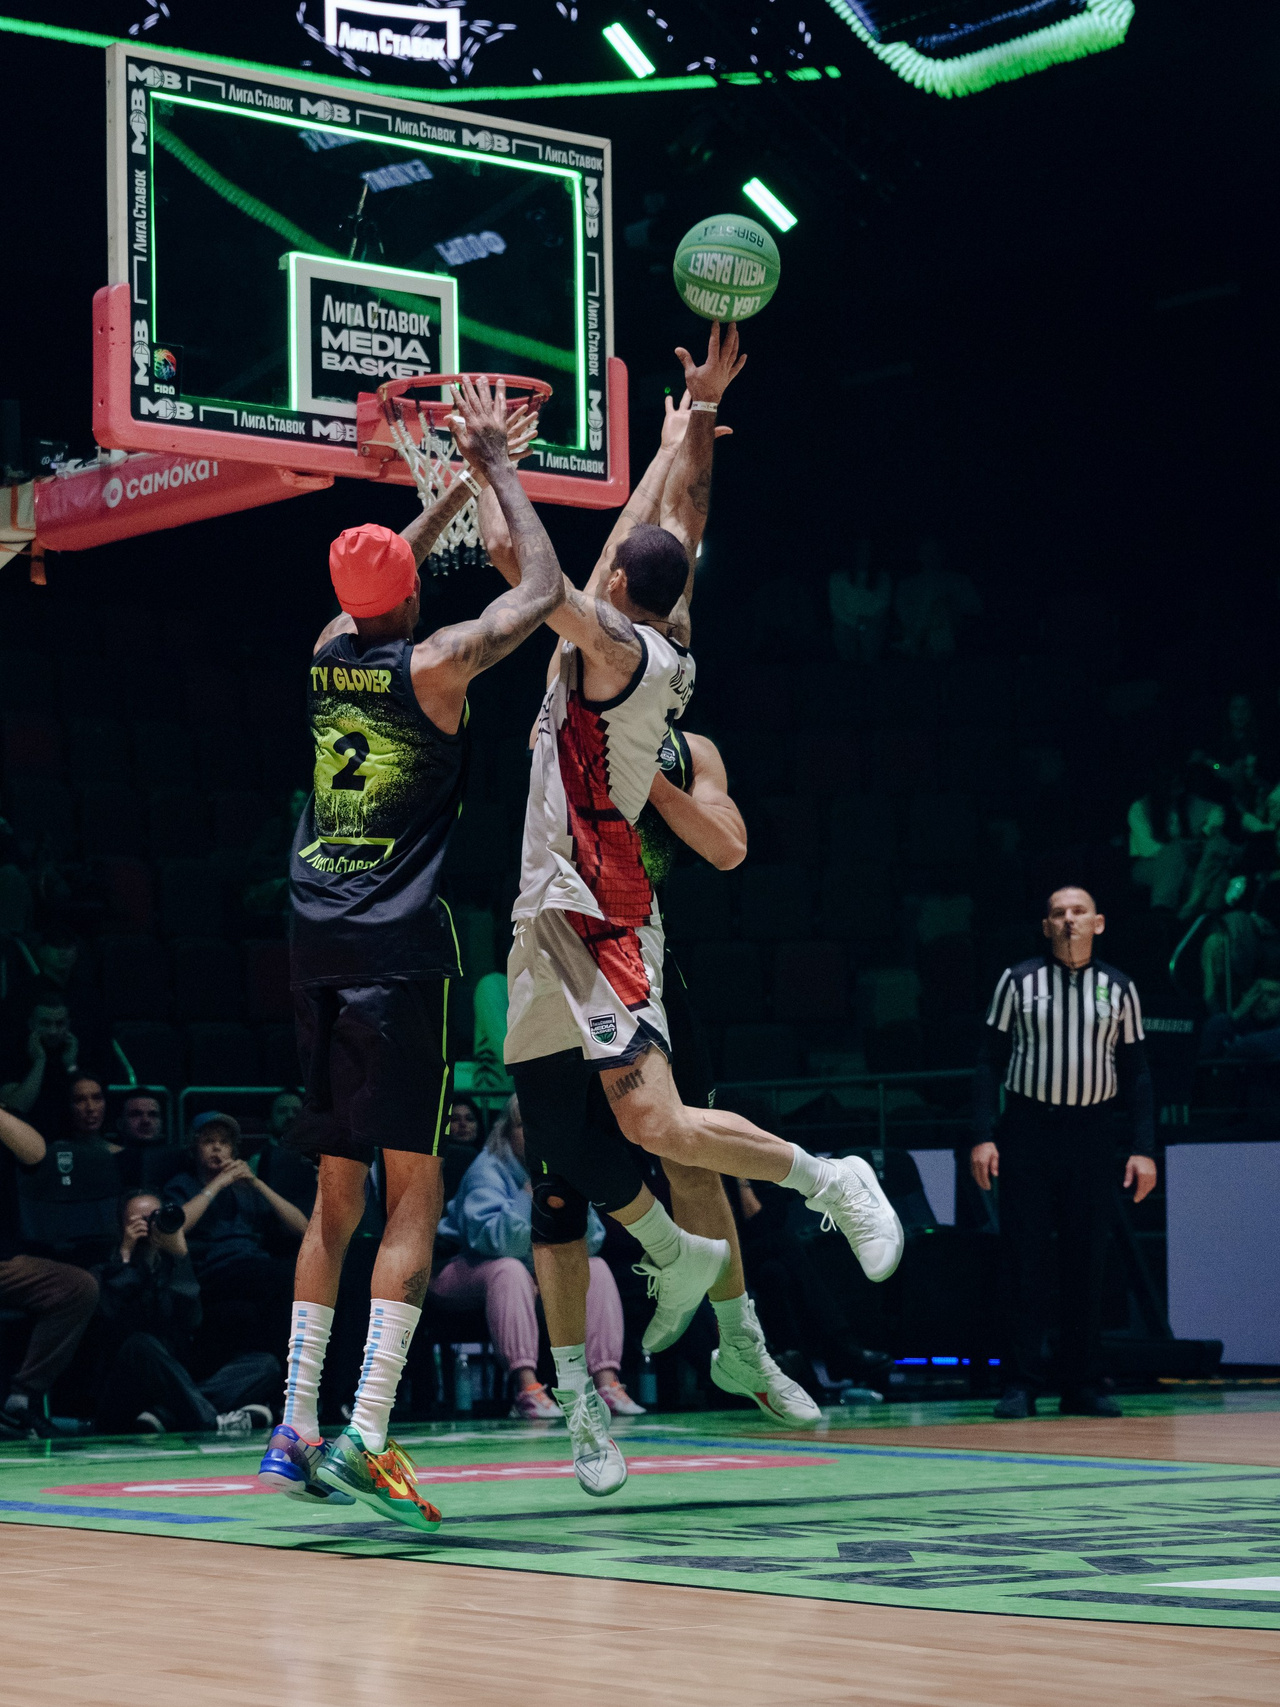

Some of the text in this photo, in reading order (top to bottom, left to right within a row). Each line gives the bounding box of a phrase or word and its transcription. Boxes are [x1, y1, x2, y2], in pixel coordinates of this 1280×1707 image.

[321, 325, 431, 364] MEDIA
[321, 351, 431, 380] BASKET
[310, 667, 392, 693] TY GLOVER
[331, 731, 370, 791] 2
